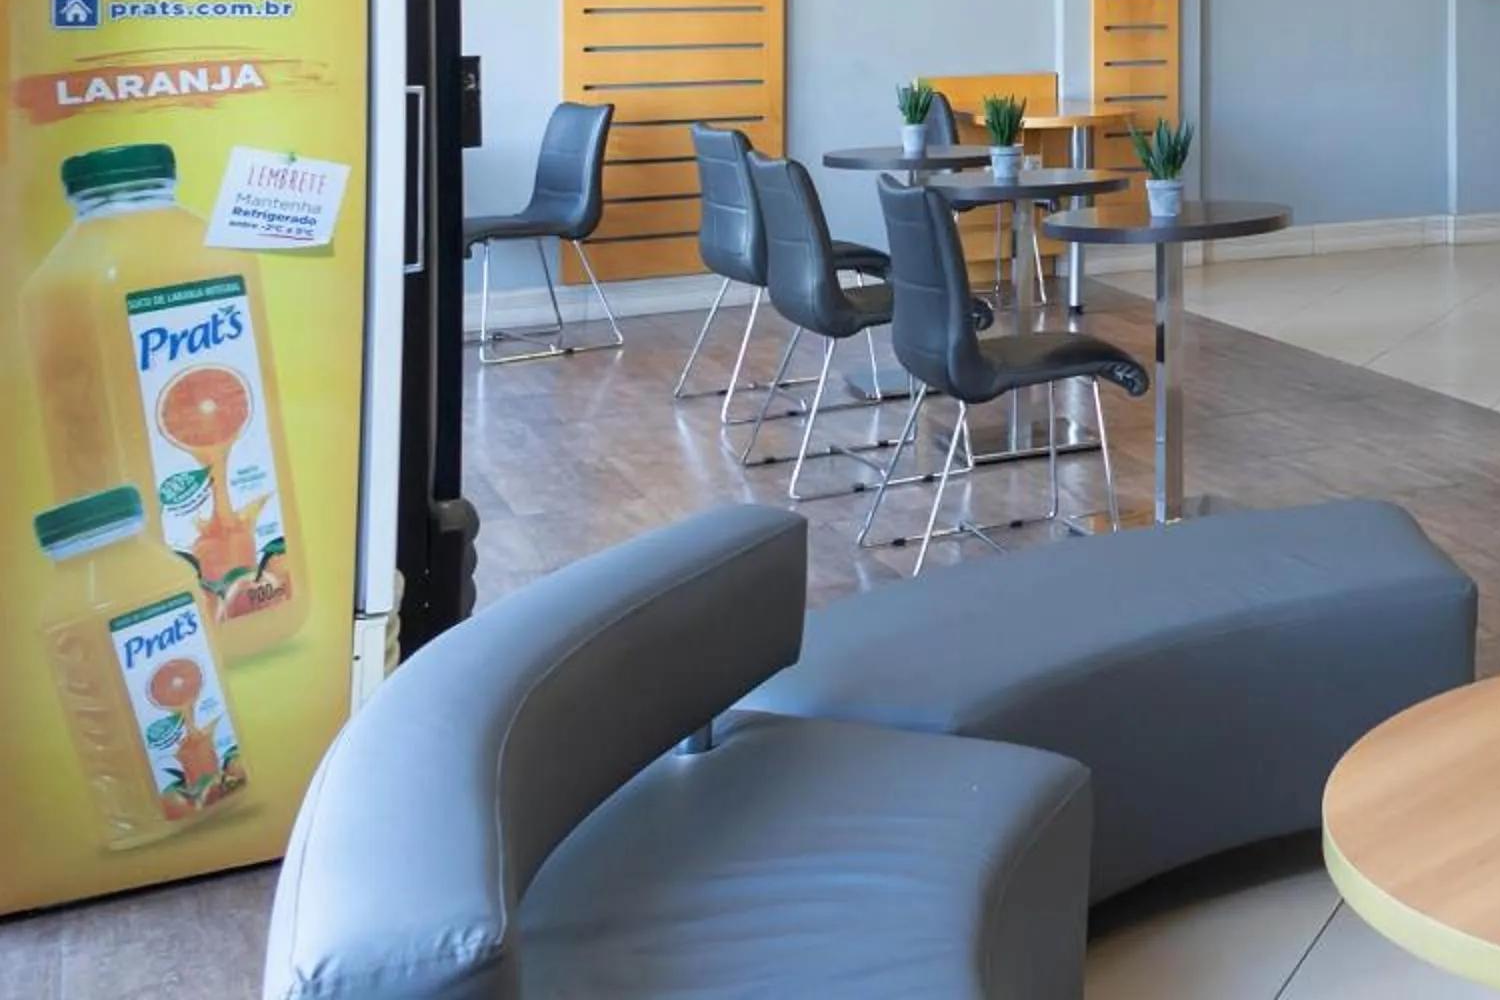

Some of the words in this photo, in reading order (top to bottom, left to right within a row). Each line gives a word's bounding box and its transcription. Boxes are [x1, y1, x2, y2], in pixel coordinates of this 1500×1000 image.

[109, 0, 293, 19] prats.com.br
[56, 64, 265, 106] LARANJA
[247, 163, 328, 195] LEMBRETE
[235, 193, 323, 215] Mantenha
[231, 205, 317, 226] Refrigerado
